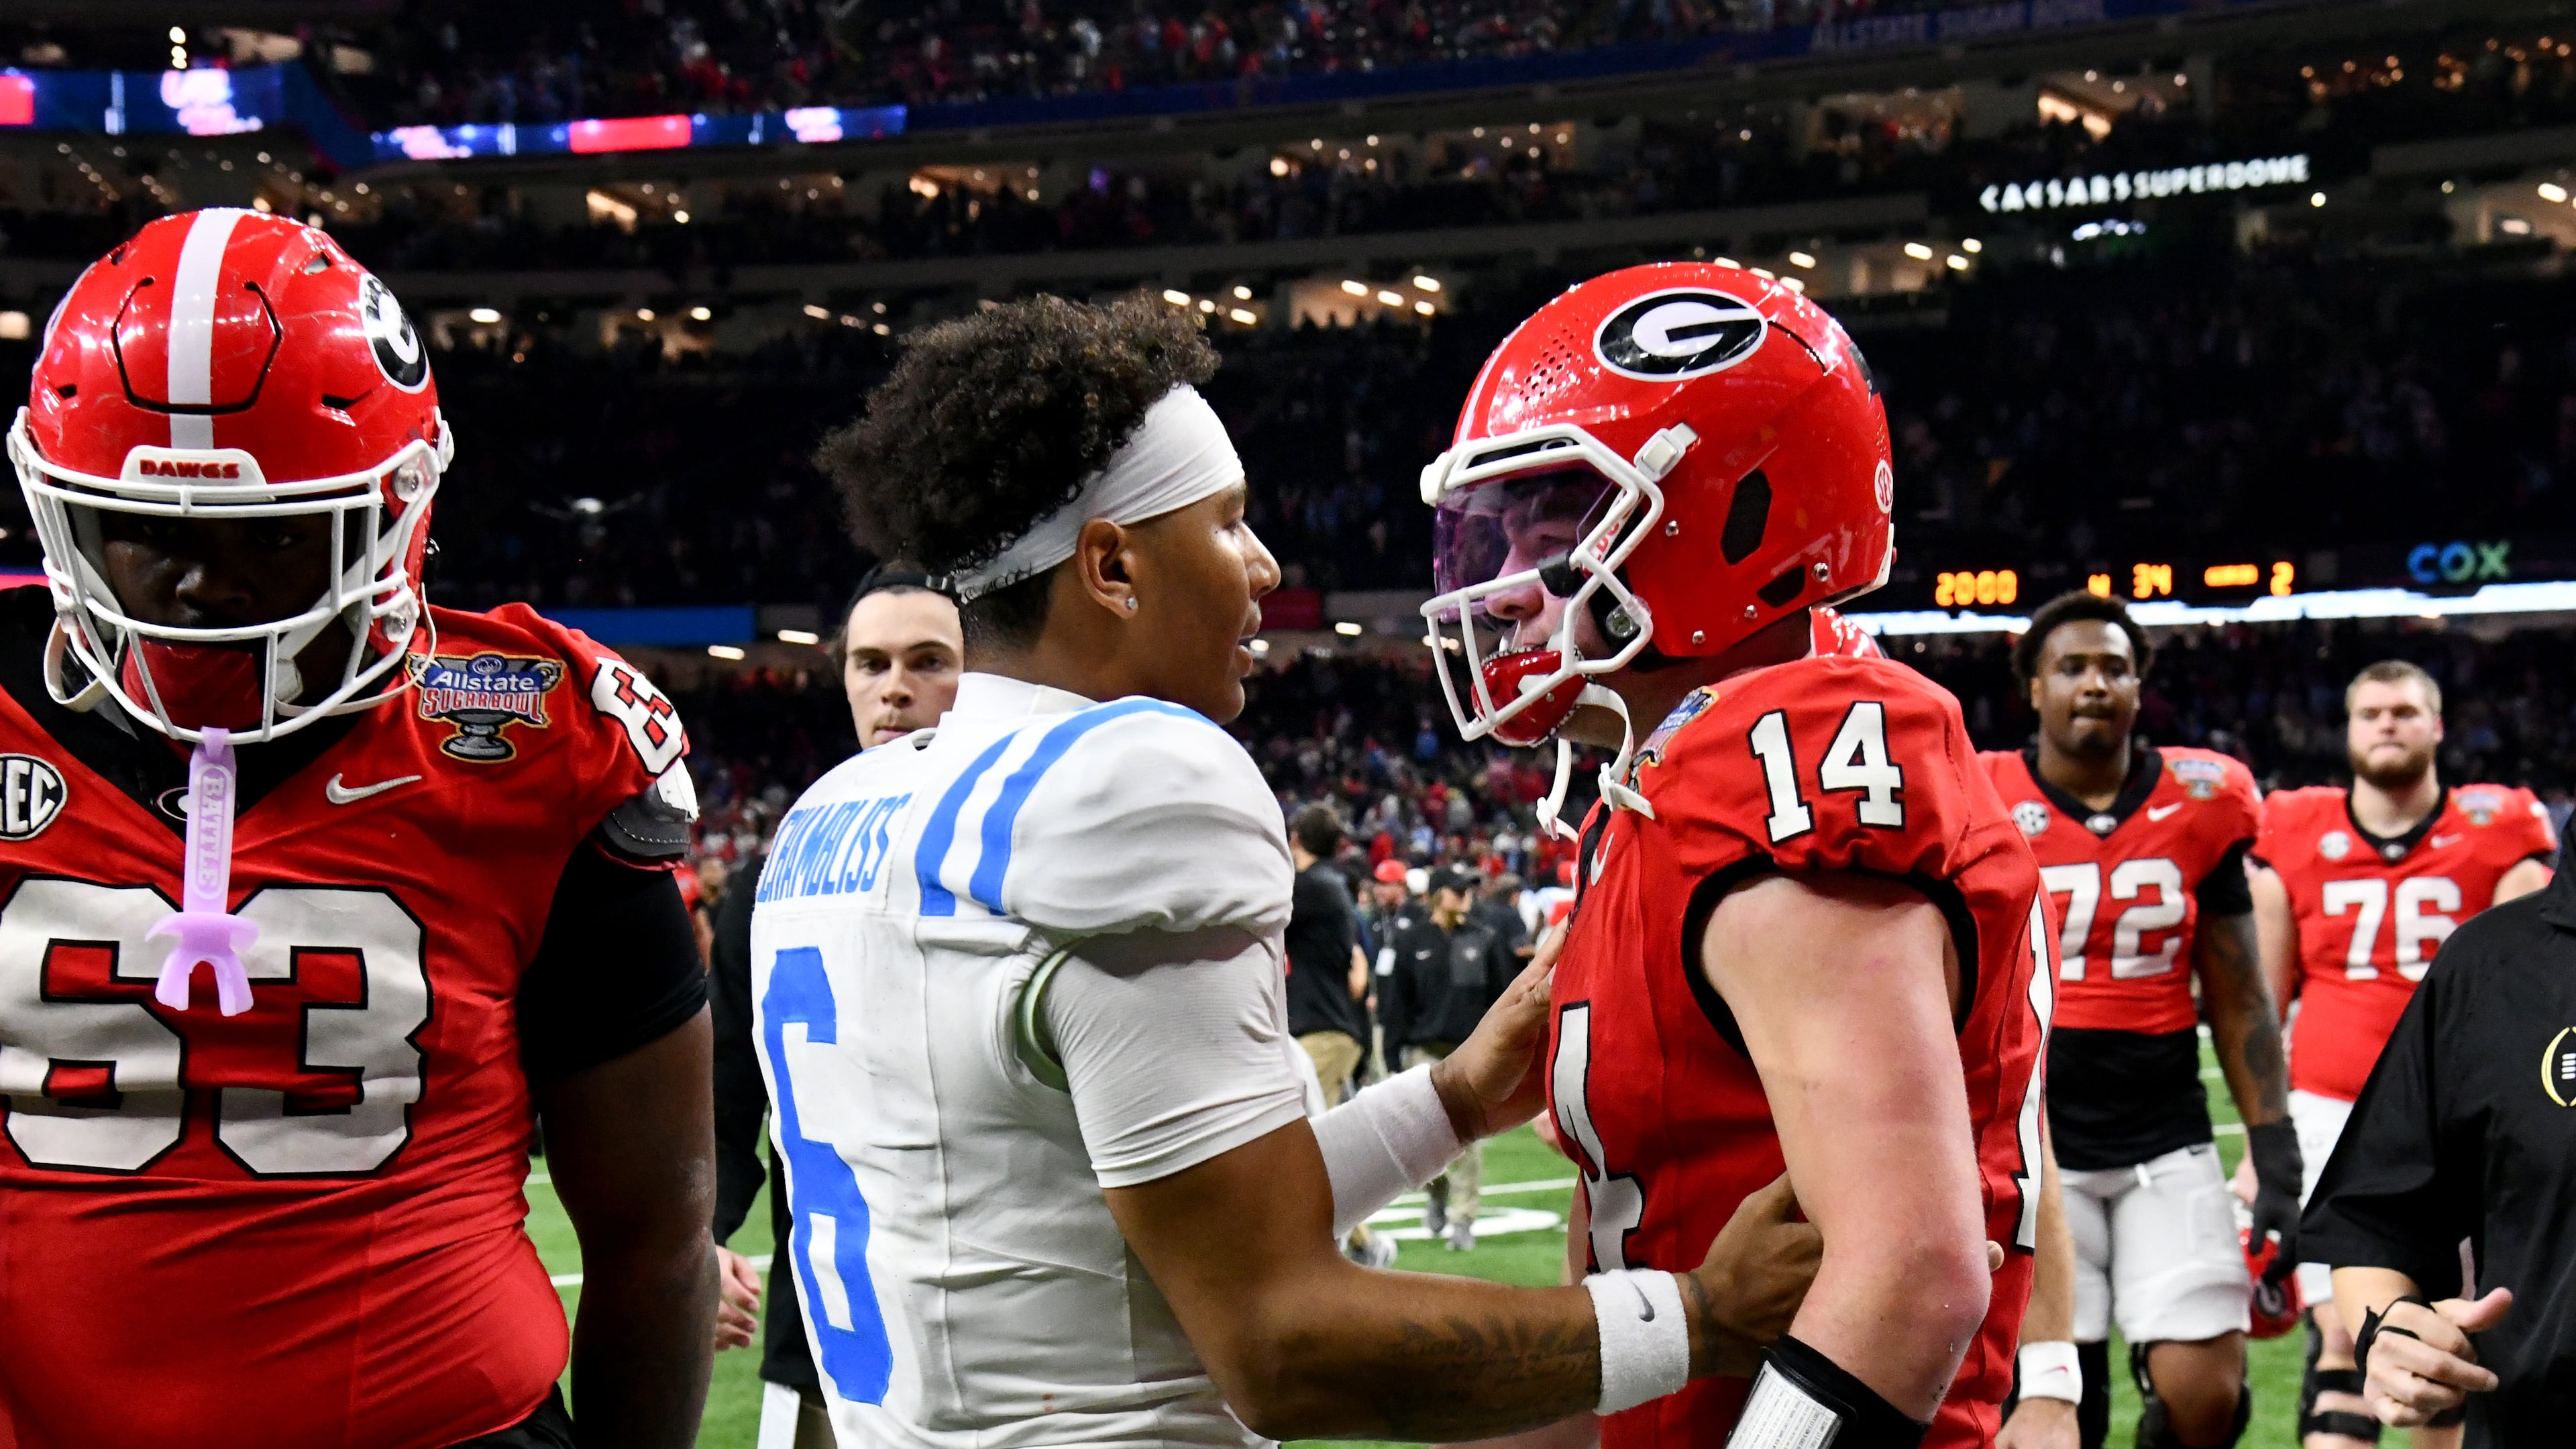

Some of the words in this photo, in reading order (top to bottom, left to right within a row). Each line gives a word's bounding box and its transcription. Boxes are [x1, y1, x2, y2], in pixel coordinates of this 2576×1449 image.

[1980, 172, 2132, 213] CAESARS
[2133, 153, 2310, 199] SUPERDOME
[140, 459, 241, 479] DAWGS
[2133, 563, 2172, 599] 34
[2270, 561, 2294, 597] 2
[2407, 539, 2511, 584] COX
[431, 670, 538, 692] Allstate
[0, 758, 58, 833] EC
[1748, 698, 1907, 848] 14
[199, 775, 225, 888] BATTLE
[757, 792, 913, 902] CHAMBLISS
[2039, 856, 2187, 983] 72
[2321, 875, 2463, 982] 76
[0, 874, 434, 1179] 63
[762, 946, 894, 1407] 6
